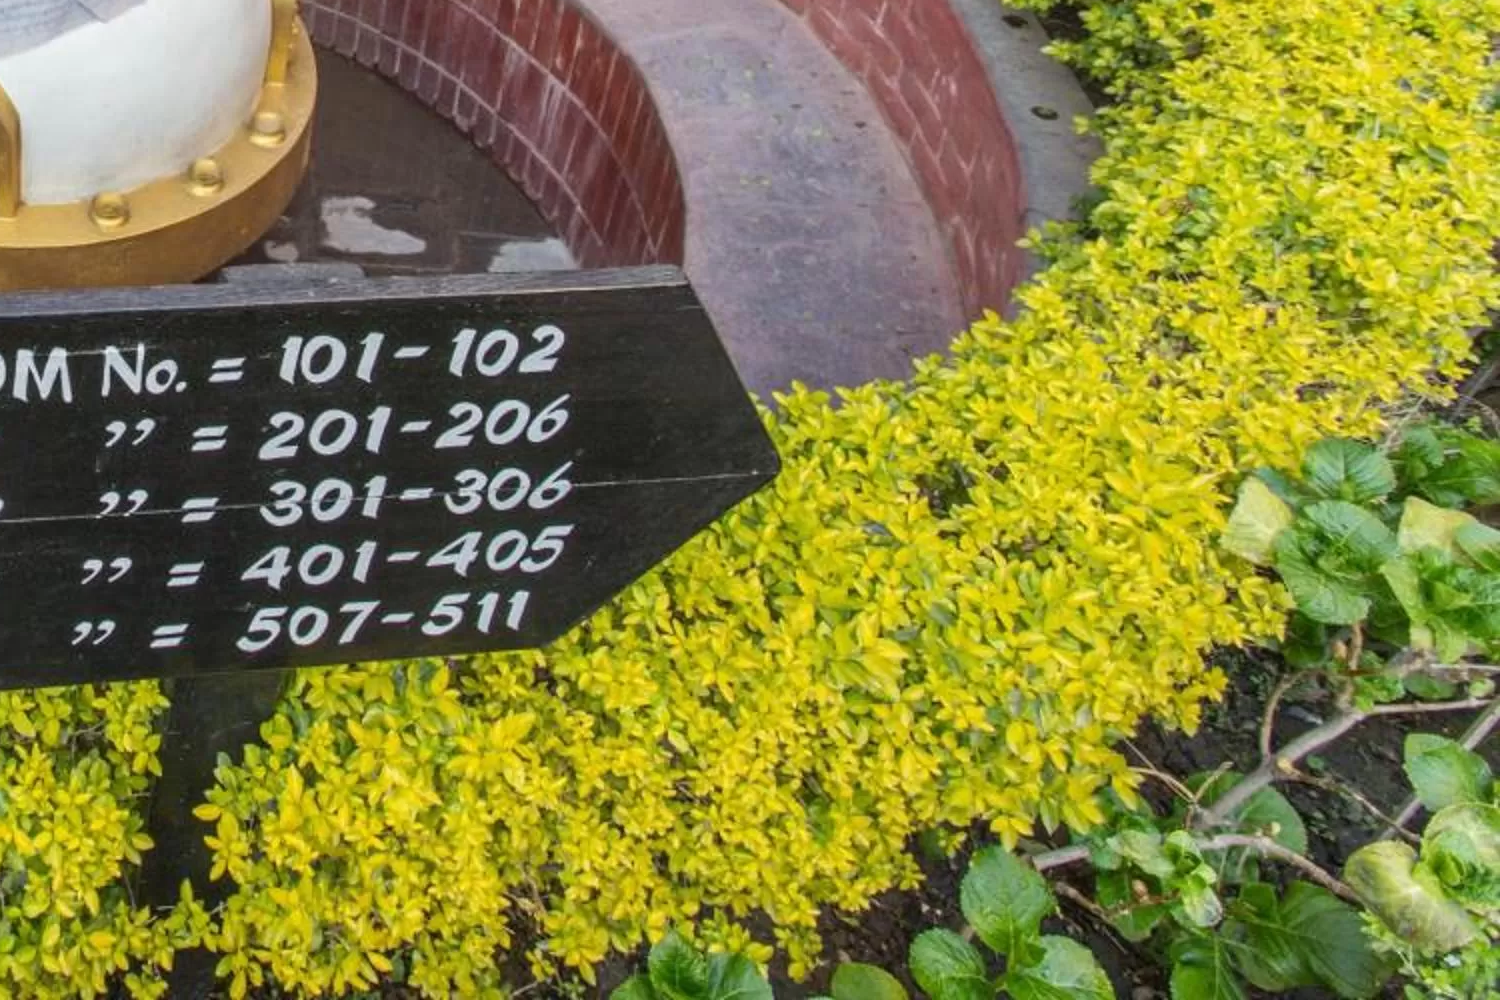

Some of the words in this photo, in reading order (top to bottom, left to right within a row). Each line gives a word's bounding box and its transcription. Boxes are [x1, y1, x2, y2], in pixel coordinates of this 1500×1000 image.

[279, 324, 565, 385] 101-102
[258, 393, 570, 461] 201-206
[259, 461, 573, 527] 301-306
[241, 524, 574, 590] 401-405
[236, 590, 530, 652] 507-511
